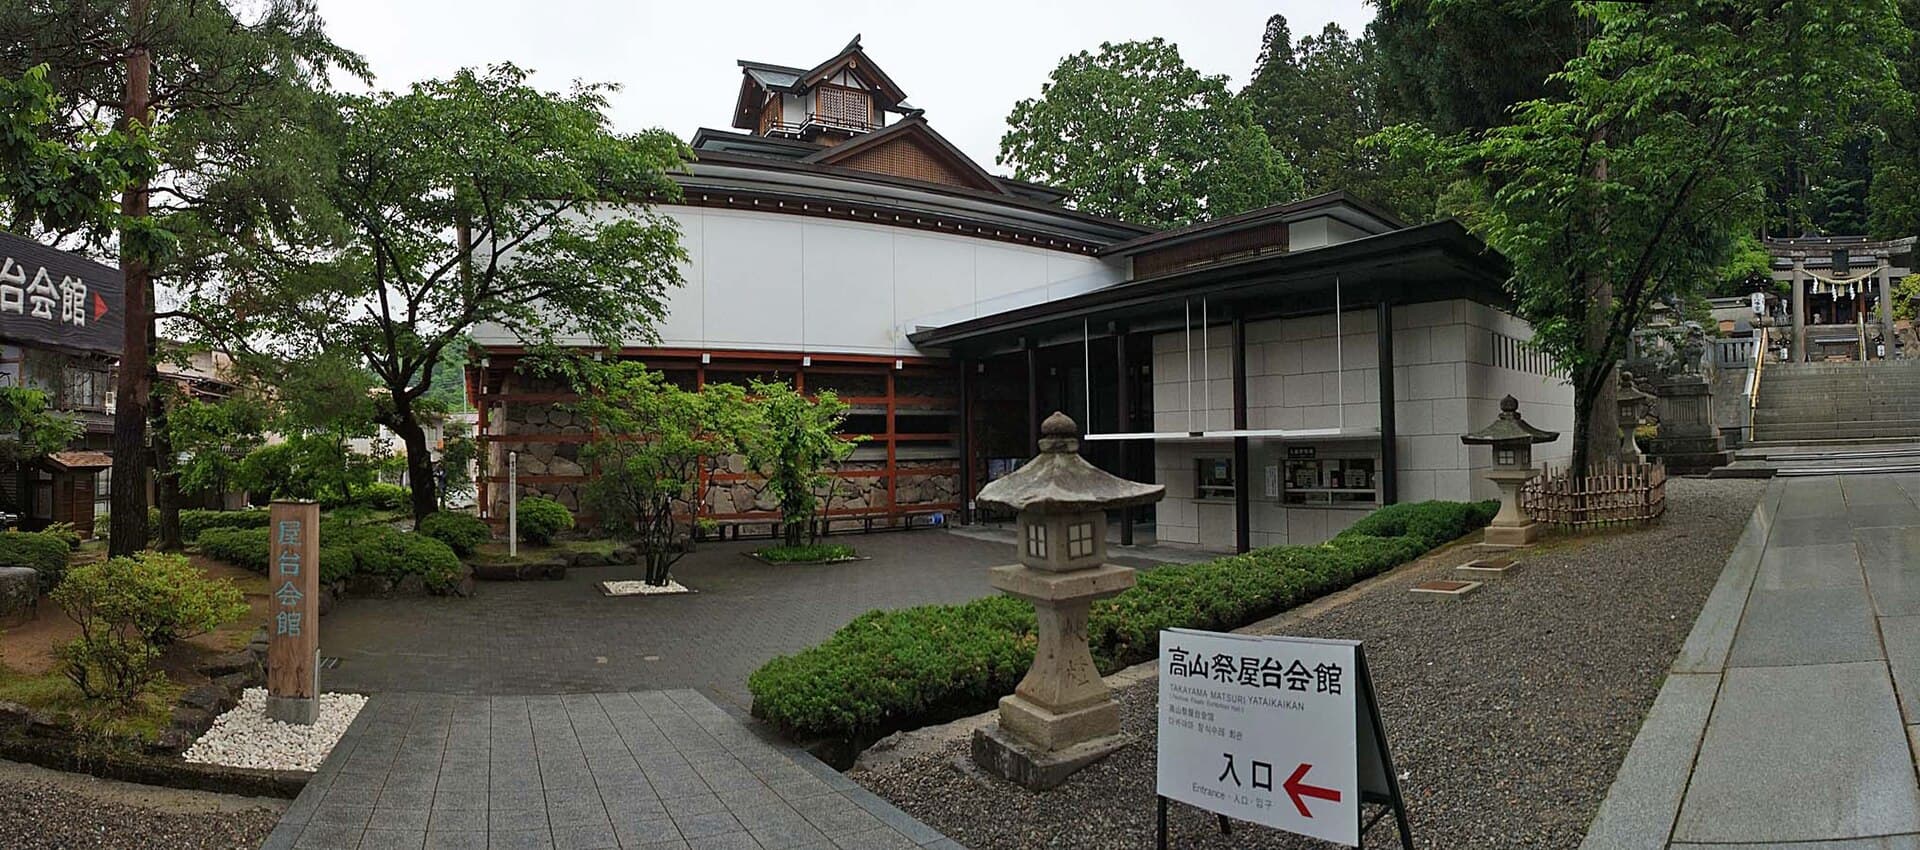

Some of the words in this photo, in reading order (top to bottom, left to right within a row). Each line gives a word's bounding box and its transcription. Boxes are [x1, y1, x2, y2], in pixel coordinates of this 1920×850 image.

[0, 257, 87, 327] 台会館
[276, 520, 304, 638] 屋台会館
[1168, 646, 1342, 695] 高山祭屋台会館
[1170, 684, 1208, 698] TAKAYAMA
[1210, 691, 1245, 704] MATSURI
[1248, 696, 1305, 711] YATAIKAIKAN
[1192, 782, 1225, 800] Entrance
[1218, 752, 1272, 792] 入口
